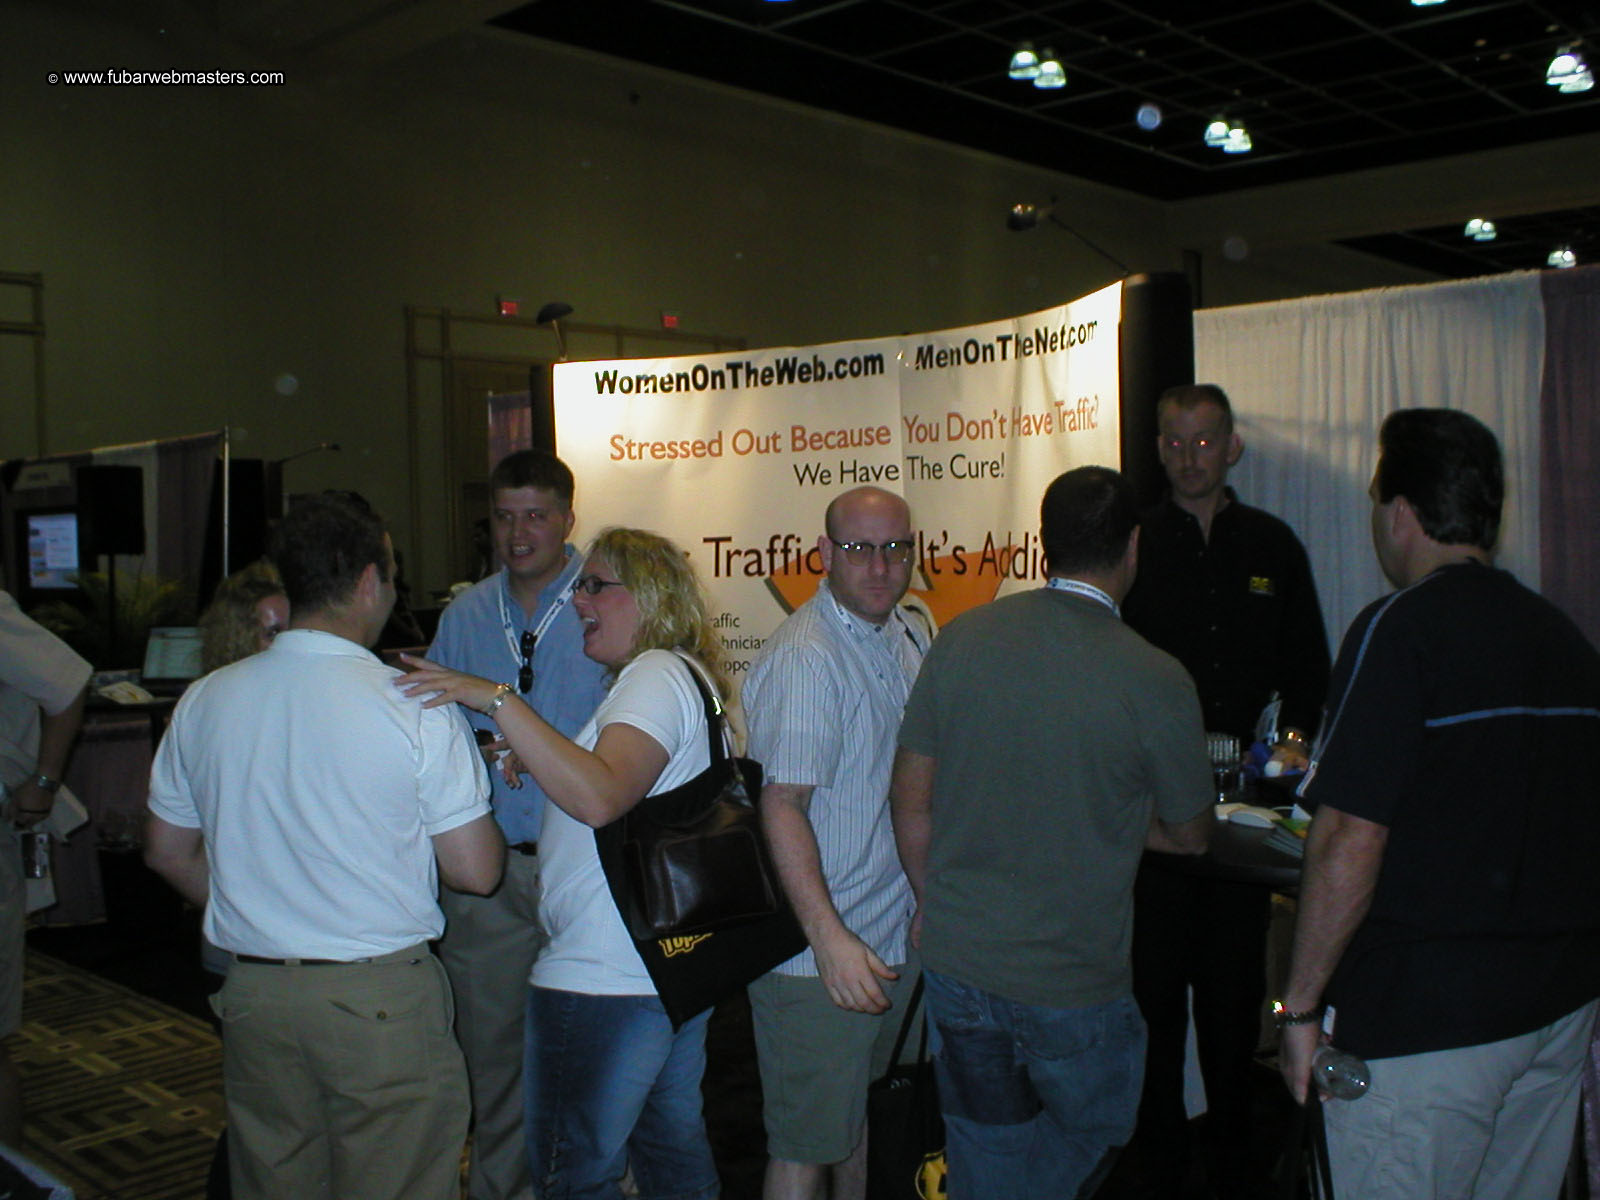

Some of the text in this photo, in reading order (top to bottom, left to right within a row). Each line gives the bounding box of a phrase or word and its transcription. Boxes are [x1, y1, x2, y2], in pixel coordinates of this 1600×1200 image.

[915, 320, 1098, 370] MenOnTheNet.com
[595, 353, 884, 394] WomenOnTheWeb.com
[609, 394, 1098, 461] Stressed Out Because You Don't Have Traffic?
[793, 452, 1005, 486] We Have The Cure!
[702, 534, 824, 577] Traffic
[918, 530, 968, 576] It's
[709, 612, 740, 629] affic
